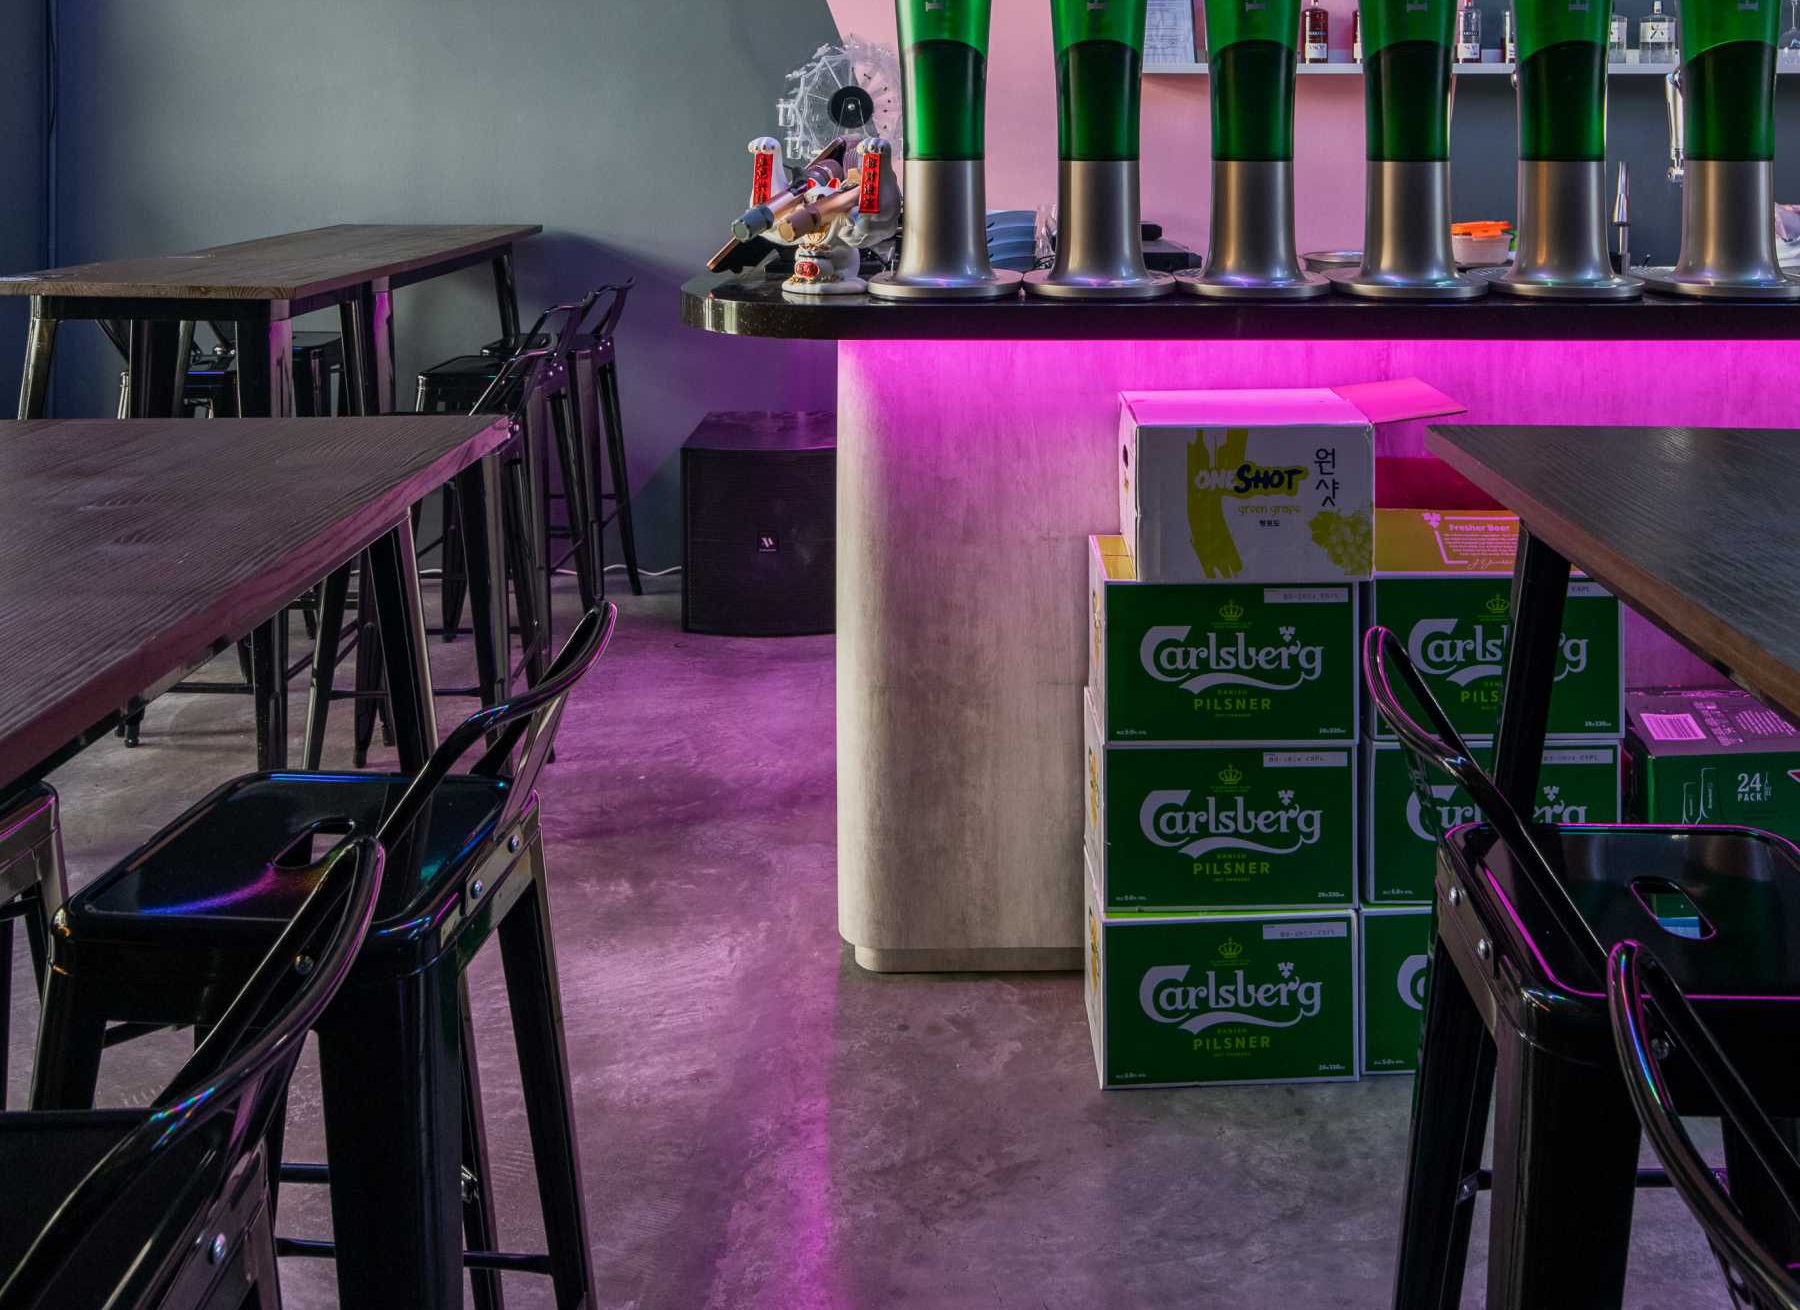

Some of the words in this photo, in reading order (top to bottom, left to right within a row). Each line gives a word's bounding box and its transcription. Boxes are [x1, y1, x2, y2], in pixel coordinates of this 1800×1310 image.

[1313, 448, 1341, 507] 원샷
[1237, 505, 1267, 515] green
[1269, 505, 1302, 516] grape
[1487, 524, 1510, 532] Beer
[1139, 625, 1325, 682] Carlsberg
[1407, 618, 1590, 675] Carlsg
[1460, 690, 1500, 703] PILS
[1193, 698, 1273, 711] PILSNER
[1737, 772, 1762, 792] 24
[1737, 792, 1763, 803] PACK
[1139, 789, 1324, 847] Carlsberg
[1193, 862, 1271, 876] PILSNER
[1139, 964, 1324, 1023] Carlsberg
[1193, 1036, 1271, 1051] PILSNER
